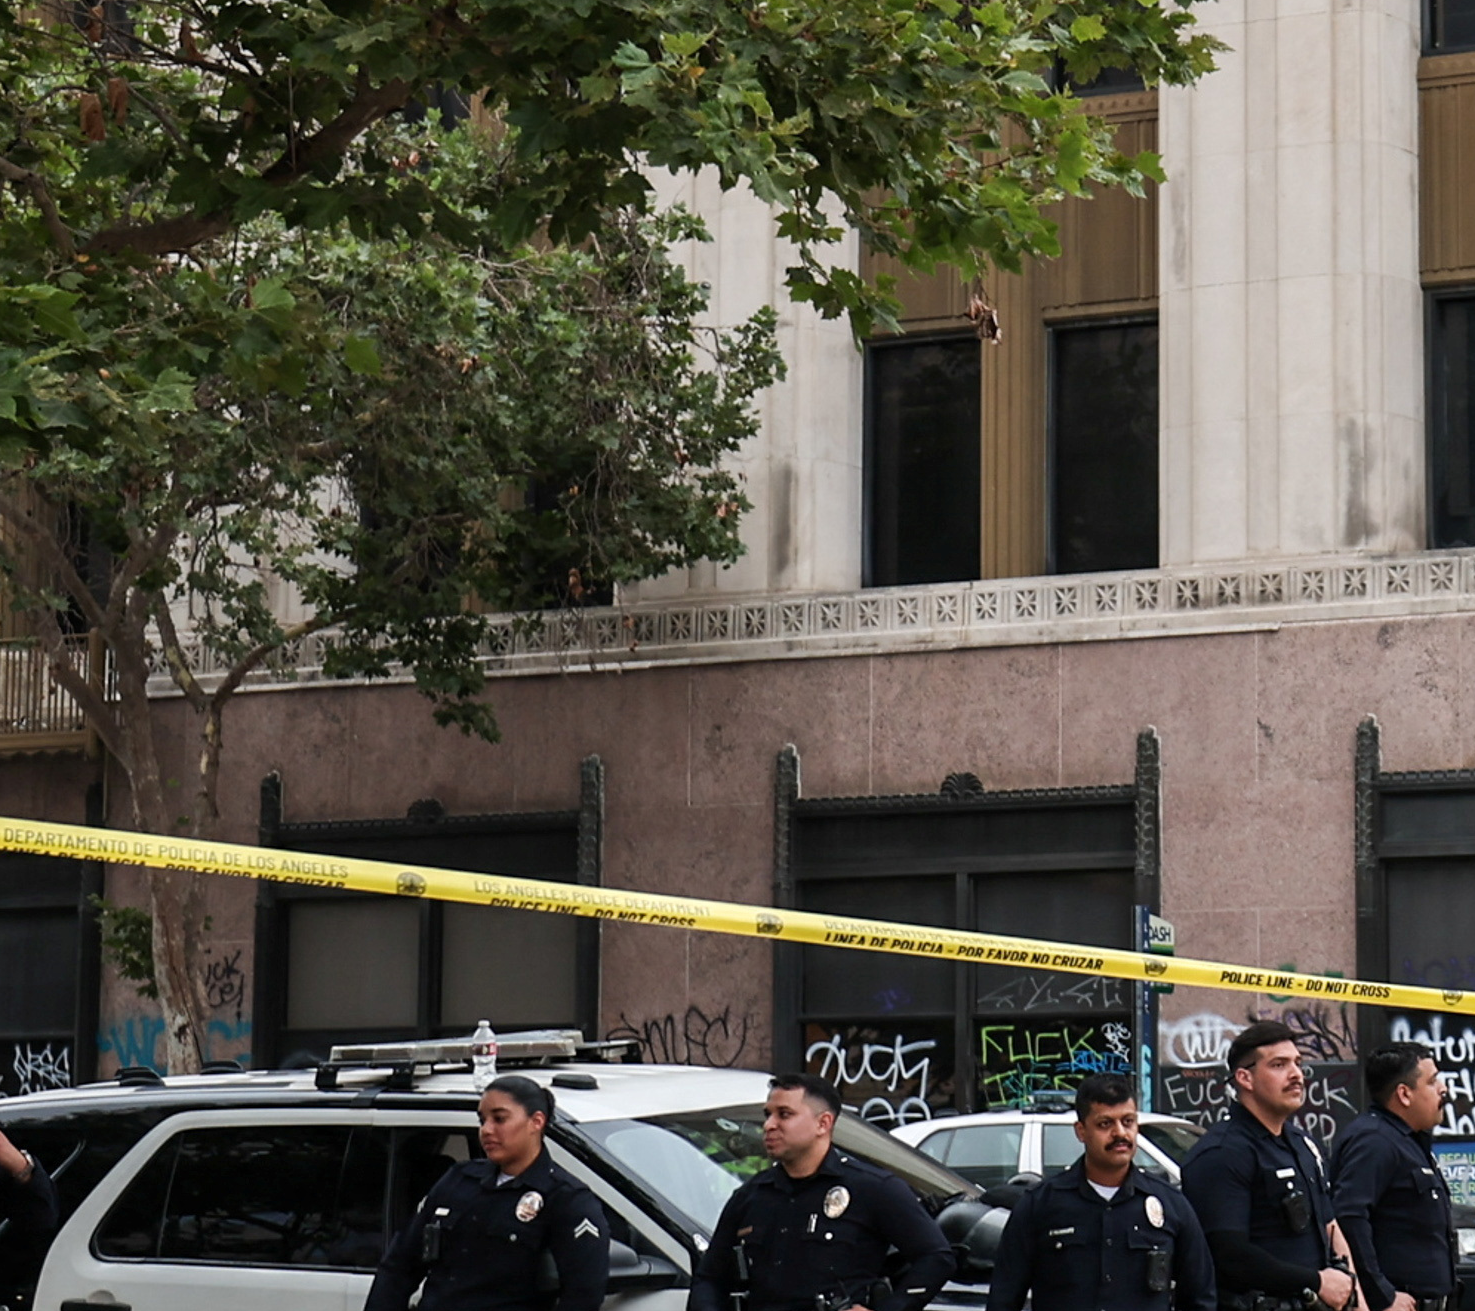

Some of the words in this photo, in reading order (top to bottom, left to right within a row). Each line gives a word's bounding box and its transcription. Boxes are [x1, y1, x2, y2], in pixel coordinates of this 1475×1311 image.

[4, 827, 129, 855] DEPARTAMENTO
[133, 842, 153, 857] DE
[159, 845, 219, 865] POLICIA
[223, 852, 243, 867] DE
[247, 856, 277, 871] LOS
[280, 859, 349, 879] ANGELES
[475, 881, 501, 894] LOS
[825, 932, 866, 945] LINEA
[869, 936, 886, 948] DE
[891, 939, 943, 954] POLICIA
[957, 945, 983, 958] POR
[986, 948, 1028, 963] FAVOR
[1031, 952, 1050, 964] NO
[1052, 954, 1104, 970] CRUZAR
[1221, 971, 1263, 986] POLICE
[1266, 974, 1294, 989] LINE
[1306, 979, 1323, 992] DO
[1325, 981, 1349, 993] NOT
[1352, 983, 1392, 998] CROSS
[982, 1024, 1103, 1072] FUCK
[1293, 1111, 1337, 1142] APD
